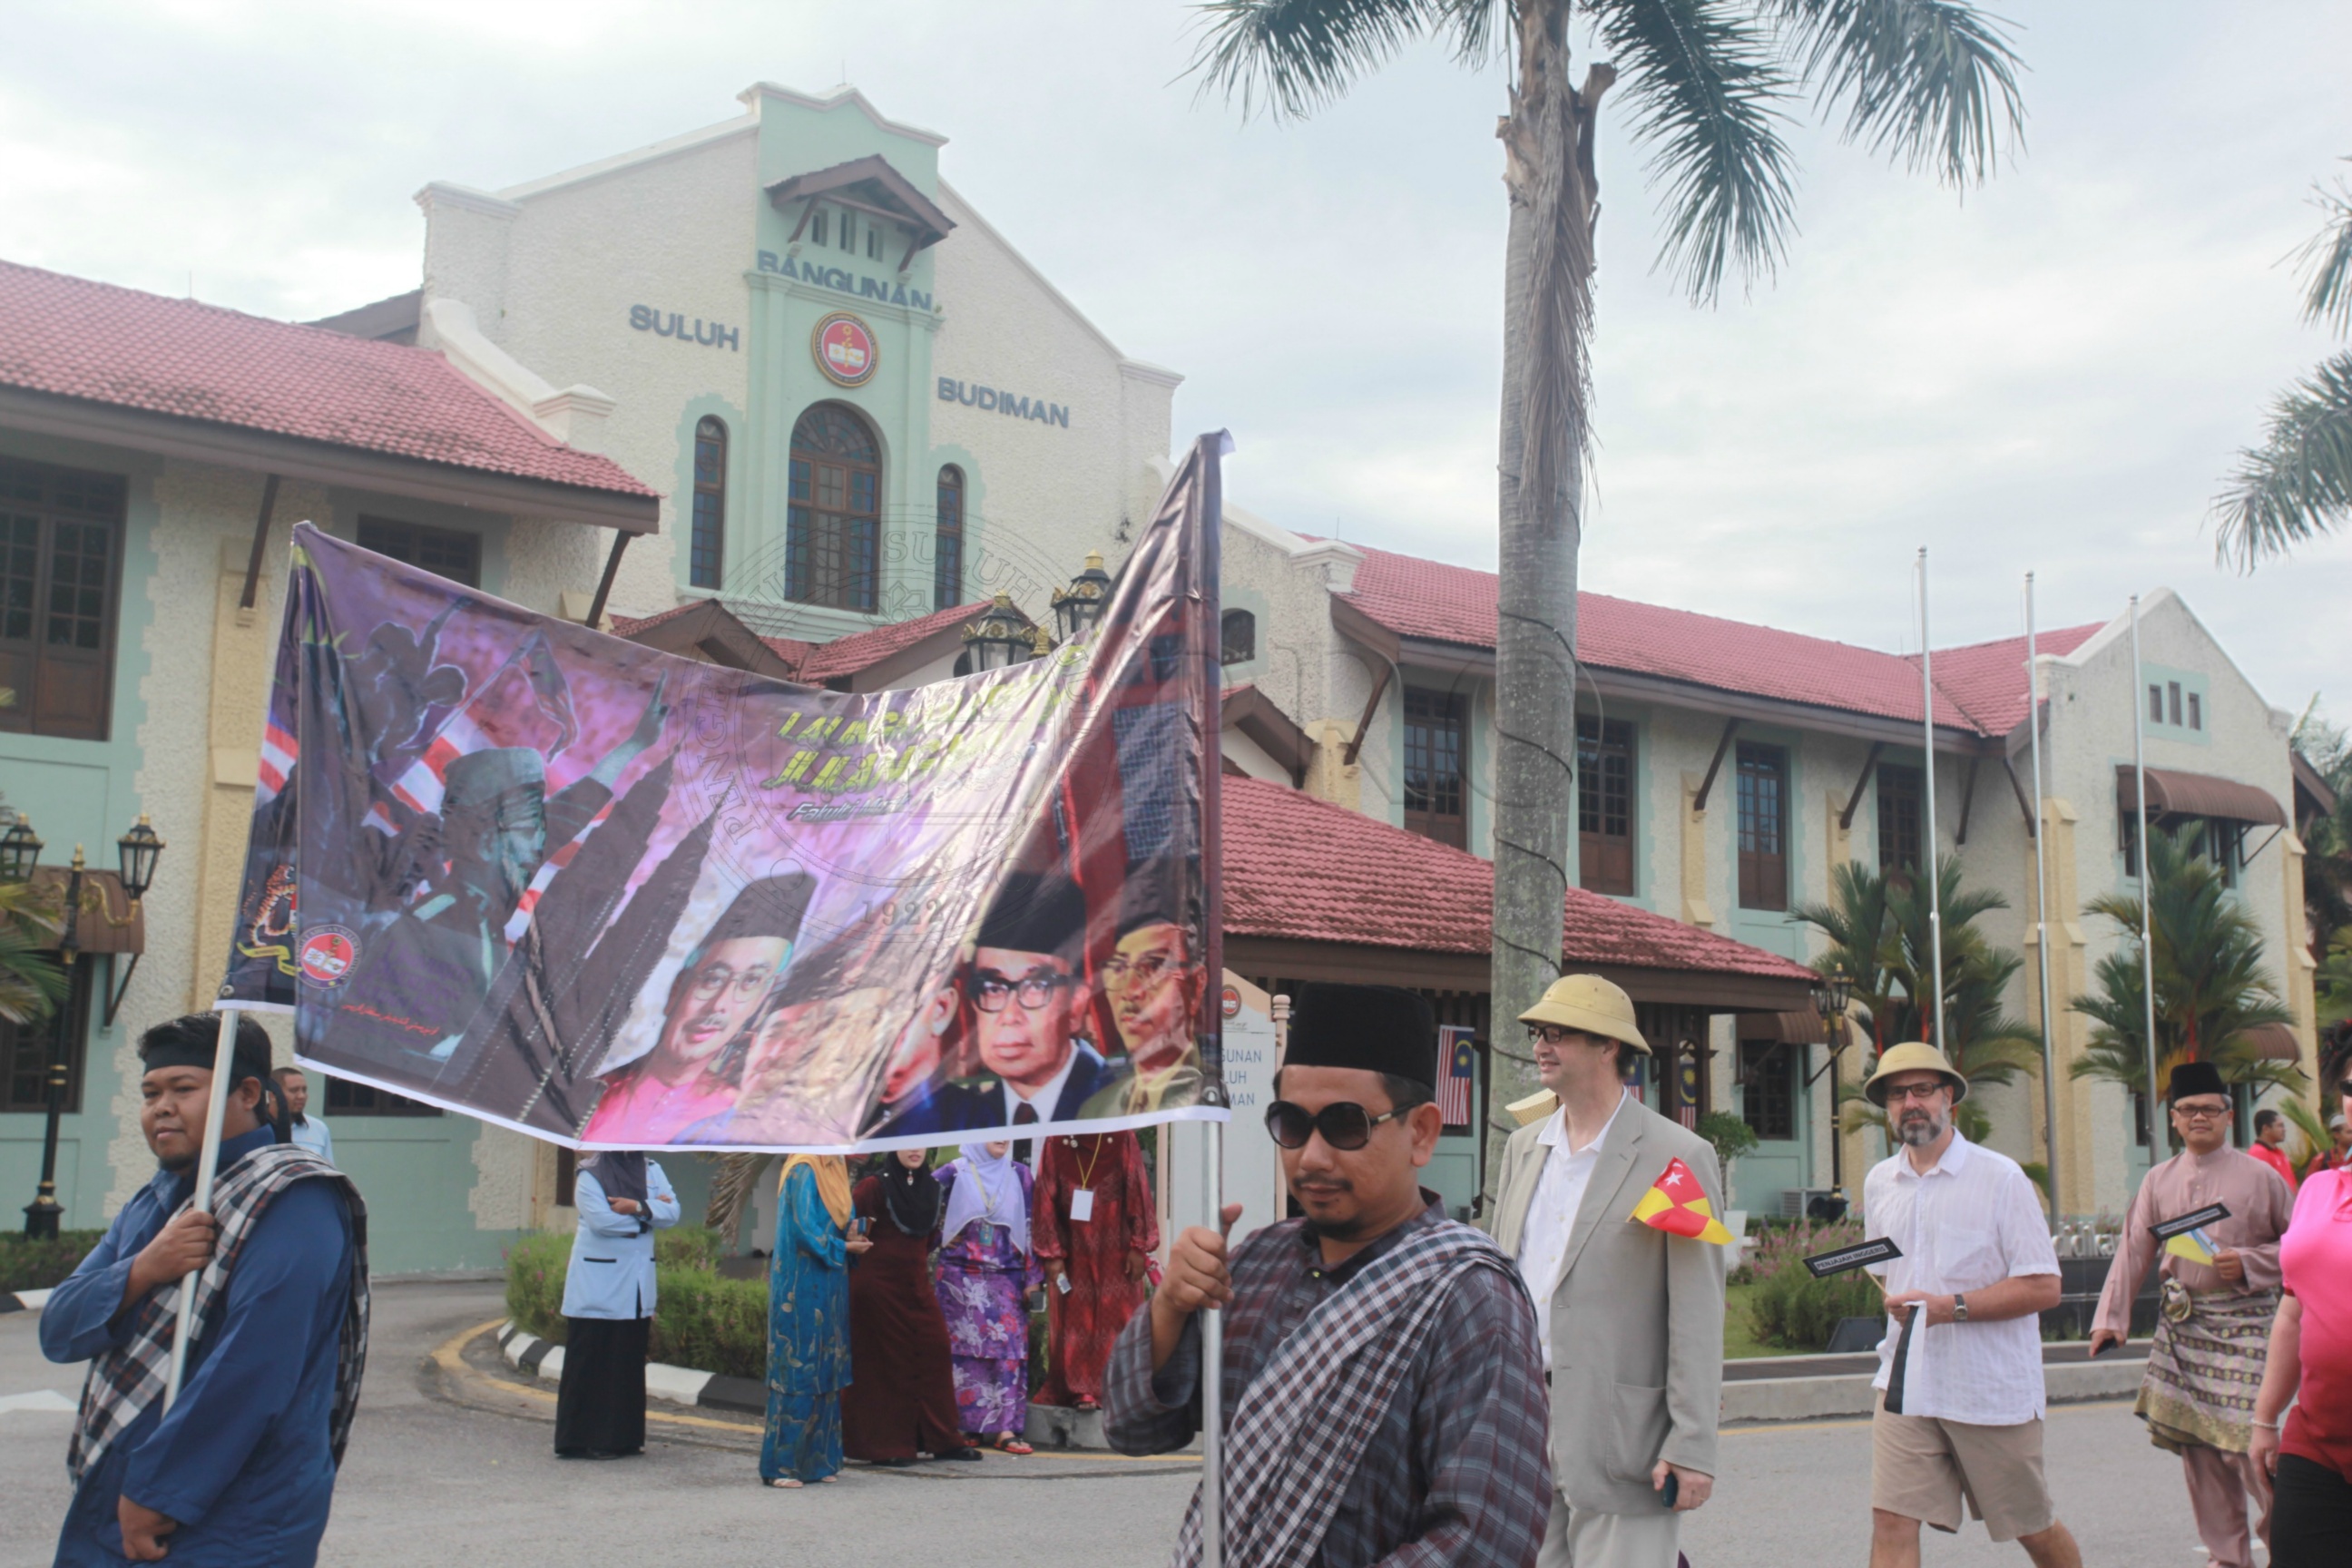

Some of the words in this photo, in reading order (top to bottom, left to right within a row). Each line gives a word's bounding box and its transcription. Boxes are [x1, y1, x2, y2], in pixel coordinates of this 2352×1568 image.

[758, 250, 932, 311] BANGUNAN
[629, 304, 740, 351] SULUH
[937, 377, 1070, 428] BUDIMAN
[789, 799, 860, 823] Fakulti
[1817, 1254, 1853, 1269] PENJAJAH
[1853, 1246, 1886, 1260] INGGERIS
